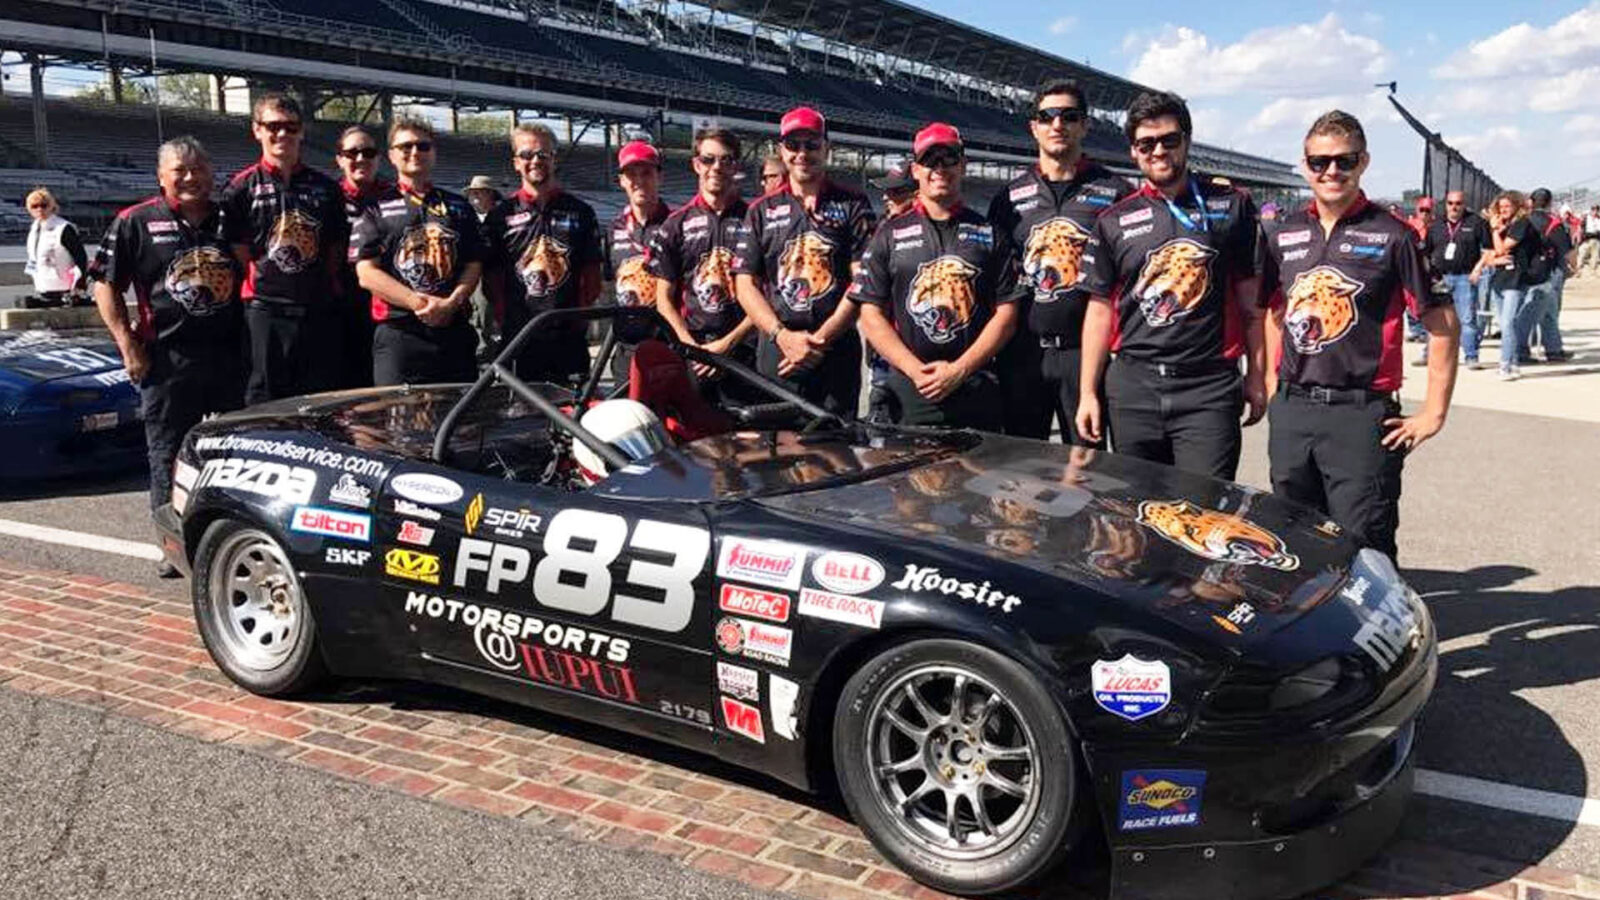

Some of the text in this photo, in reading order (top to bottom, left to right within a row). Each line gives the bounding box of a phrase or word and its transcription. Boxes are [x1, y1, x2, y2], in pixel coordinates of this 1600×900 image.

[194, 457, 318, 504] mazda
[301, 512, 365, 536] tilton
[325, 547, 372, 566] SKF
[453, 537, 531, 594] FP
[533, 508, 711, 633] 83
[727, 589, 783, 616] MoTeC
[891, 563, 1022, 613] Hoosier
[404, 591, 631, 662] MOTORSPORTS
[519, 642, 640, 703] IUPUI
[1128, 786, 1196, 805] SUNOCO
